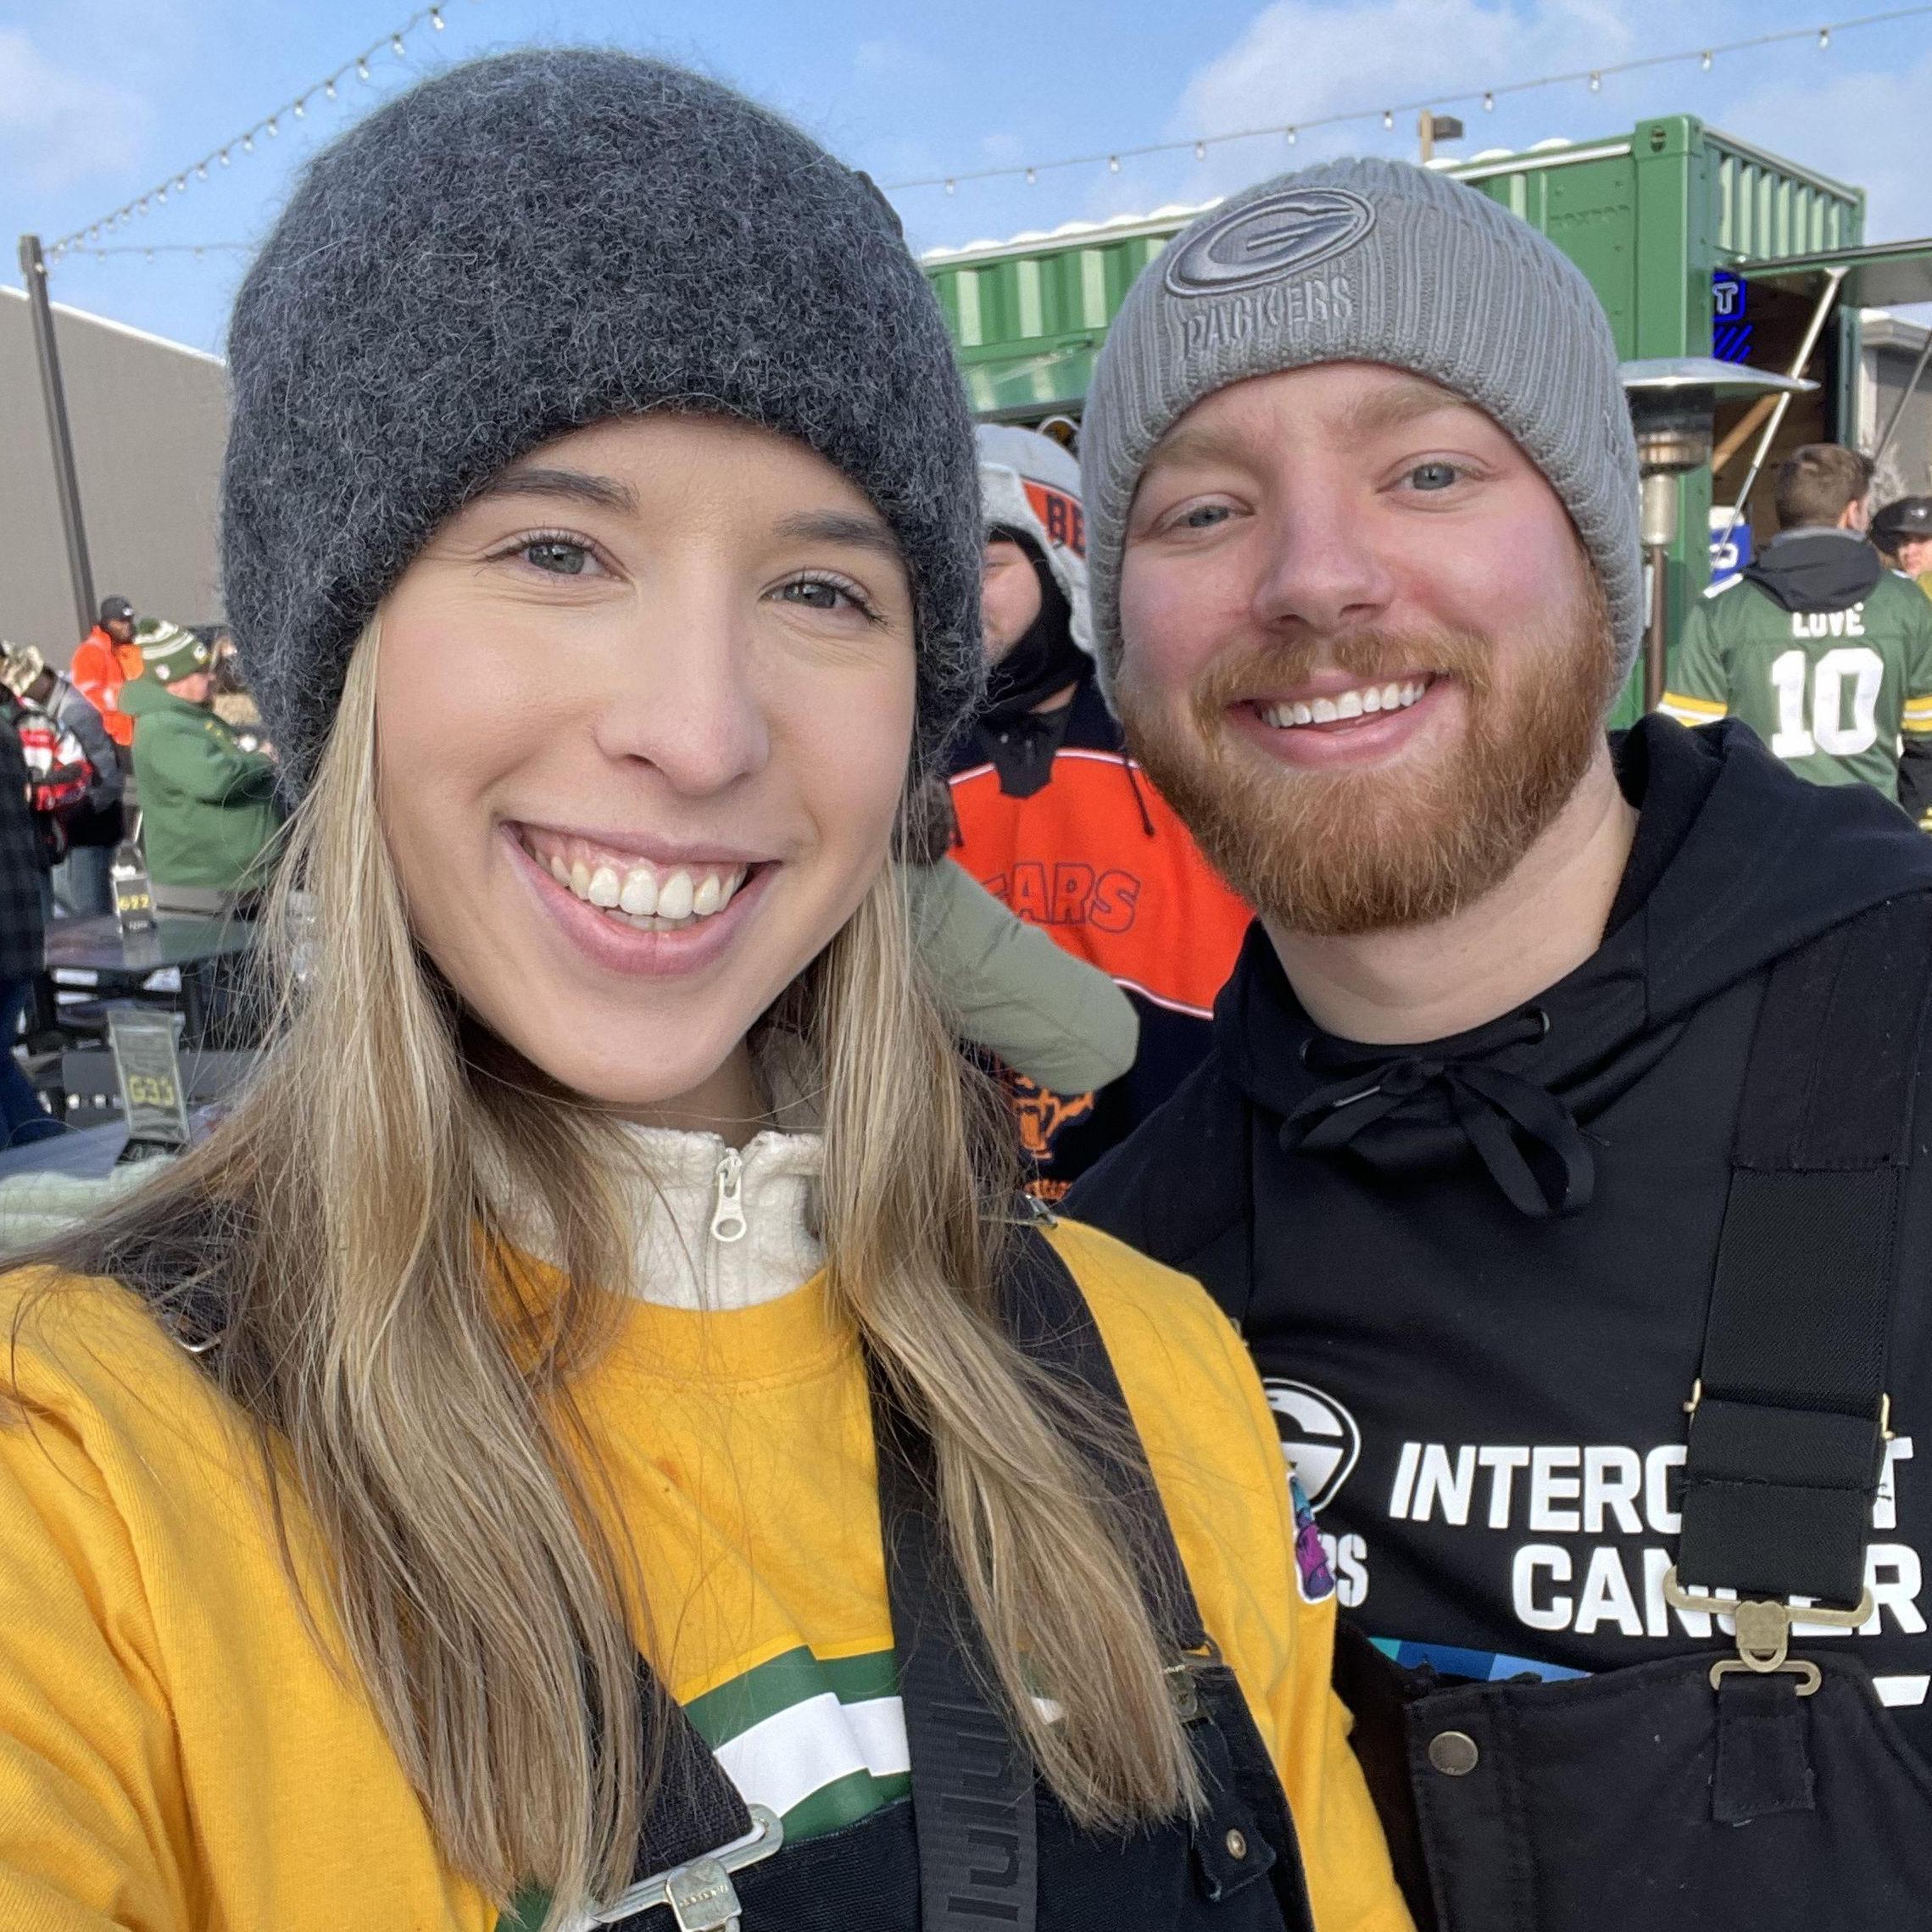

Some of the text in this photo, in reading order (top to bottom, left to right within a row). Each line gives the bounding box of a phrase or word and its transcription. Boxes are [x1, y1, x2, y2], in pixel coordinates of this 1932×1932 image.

[1185, 276, 1354, 349] PACKERS
[1792, 603, 1865, 637] LOVE
[1771, 648, 1885, 759] 10
[982, 860, 1141, 934] ARS
[1388, 1436, 1913, 1535] INTERCT
